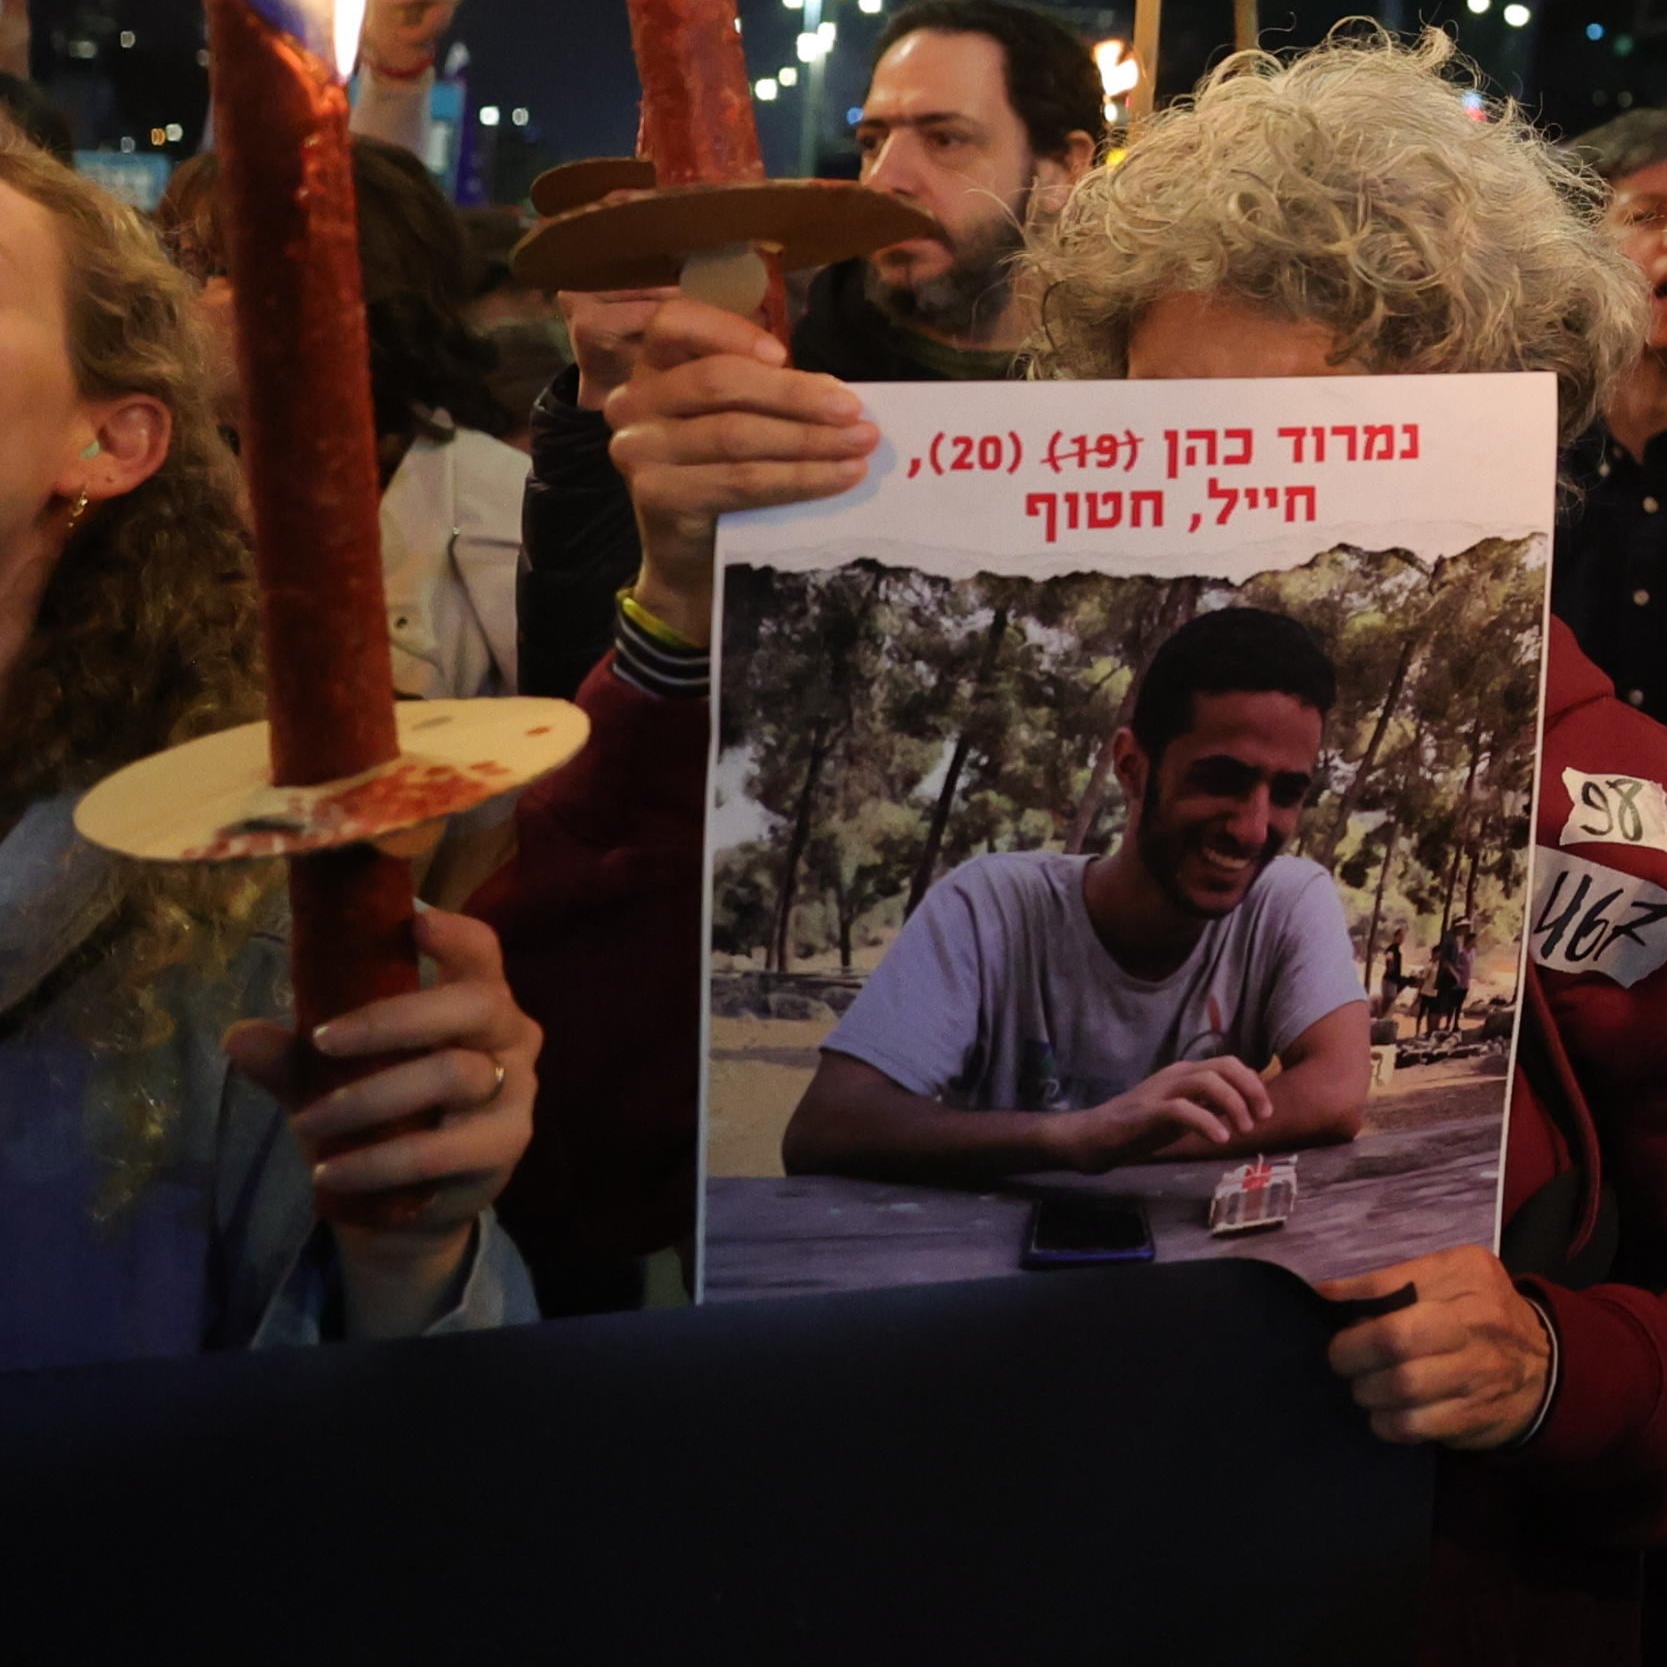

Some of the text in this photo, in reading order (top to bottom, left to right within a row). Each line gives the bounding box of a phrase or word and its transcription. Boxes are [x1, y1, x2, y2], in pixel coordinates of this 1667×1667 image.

[907, 423, 1420, 480] נמרוד כהן (19) (20),
[1025, 478, 1317, 543] חייל, חטוף
[1580, 778, 1643, 842] 98
